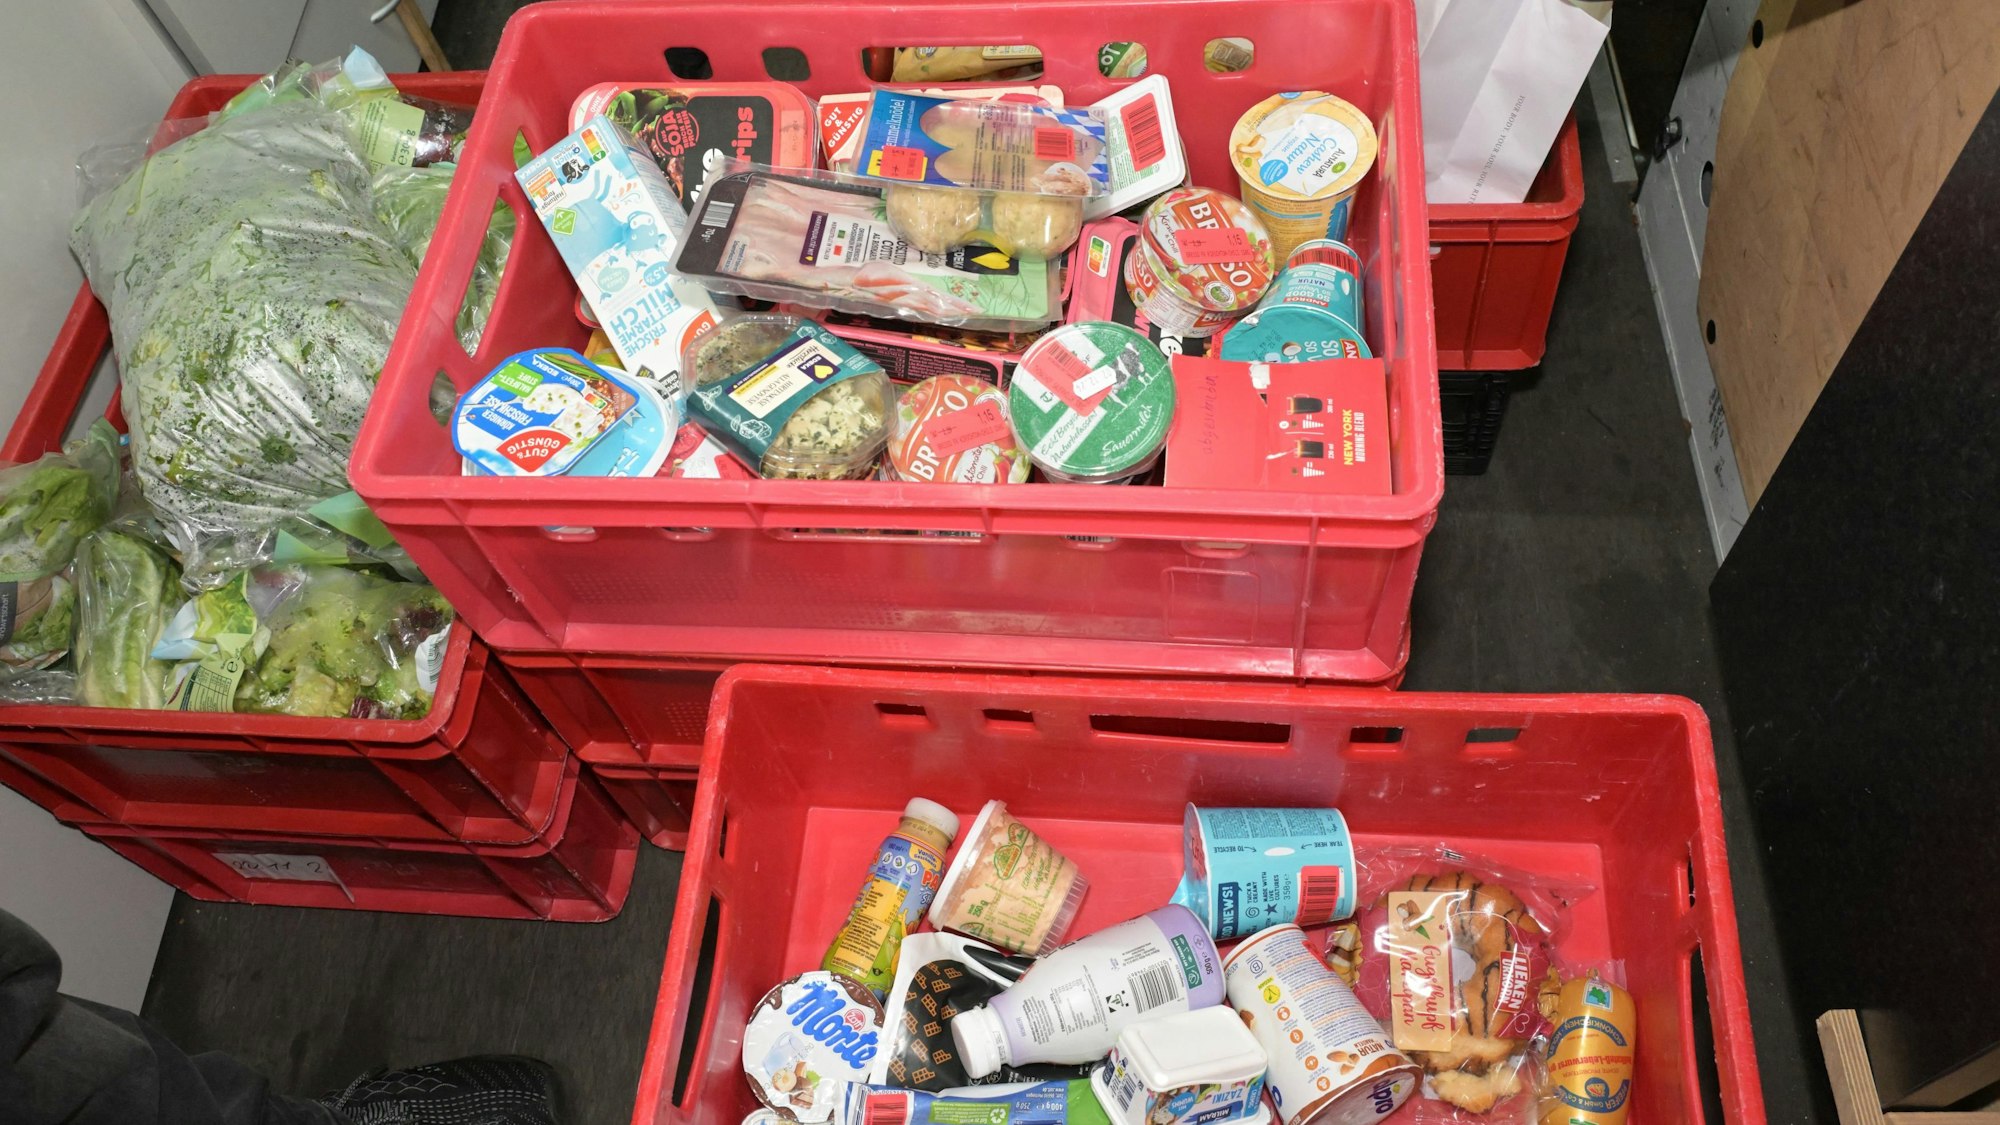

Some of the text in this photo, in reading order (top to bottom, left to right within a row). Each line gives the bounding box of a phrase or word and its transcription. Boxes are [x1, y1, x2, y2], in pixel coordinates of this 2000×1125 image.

[822, 106, 842, 128] GUT
[1512, 94, 1525, 112] YOUR
[661, 109, 684, 157] SOJA
[679, 124, 689, 148] REICH
[680, 109, 695, 147] PROTEIN
[825, 103, 864, 149] GÜNSTIG
[833, 117, 843, 127] &
[882, 98, 904, 146] emmelknödel
[1283, 127, 1320, 171] Natur
[1295, 130, 1337, 182] Cashew
[1491, 133, 1506, 153] YOUR
[1312, 143, 1345, 183] ALNATURA
[1297, 277, 1325, 287] NATUR
[606, 281, 676, 335] MILCH
[1285, 295, 1326, 308] ANDROS
[616, 297, 683, 346] FETTARME
[622, 322, 668, 358] FRISCHE
[1320, 340, 1338, 356] SO
[516, 370, 538, 385] STUFE
[530, 358, 560, 377] EDEKA
[799, 354, 822, 371] EDEKA
[479, 392, 535, 427] FRISCHKÄSE
[479, 408, 516, 432] KÖRNIGER
[505, 435, 562, 458] GÜNSTIG
[1101, 403, 1154, 458] Sauermilch
[1341, 408, 1353, 464] NEW YORK
[1353, 411, 1366, 461] MORNING BLEND
[1220, 885, 1236, 924] NEWS!
[1496, 958, 1516, 1004] URKORN
[1507, 957, 1530, 1009] LIEKEN
[785, 979, 878, 1070] Monte
[844, 1010, 867, 1030] Zott
[1356, 1037, 1385, 1061] NATUR
[1210, 1088, 1243, 1103] ZAZIKI
[1372, 1077, 1394, 1115] alpro
[1198, 1108, 1230, 1121] MILRAM
